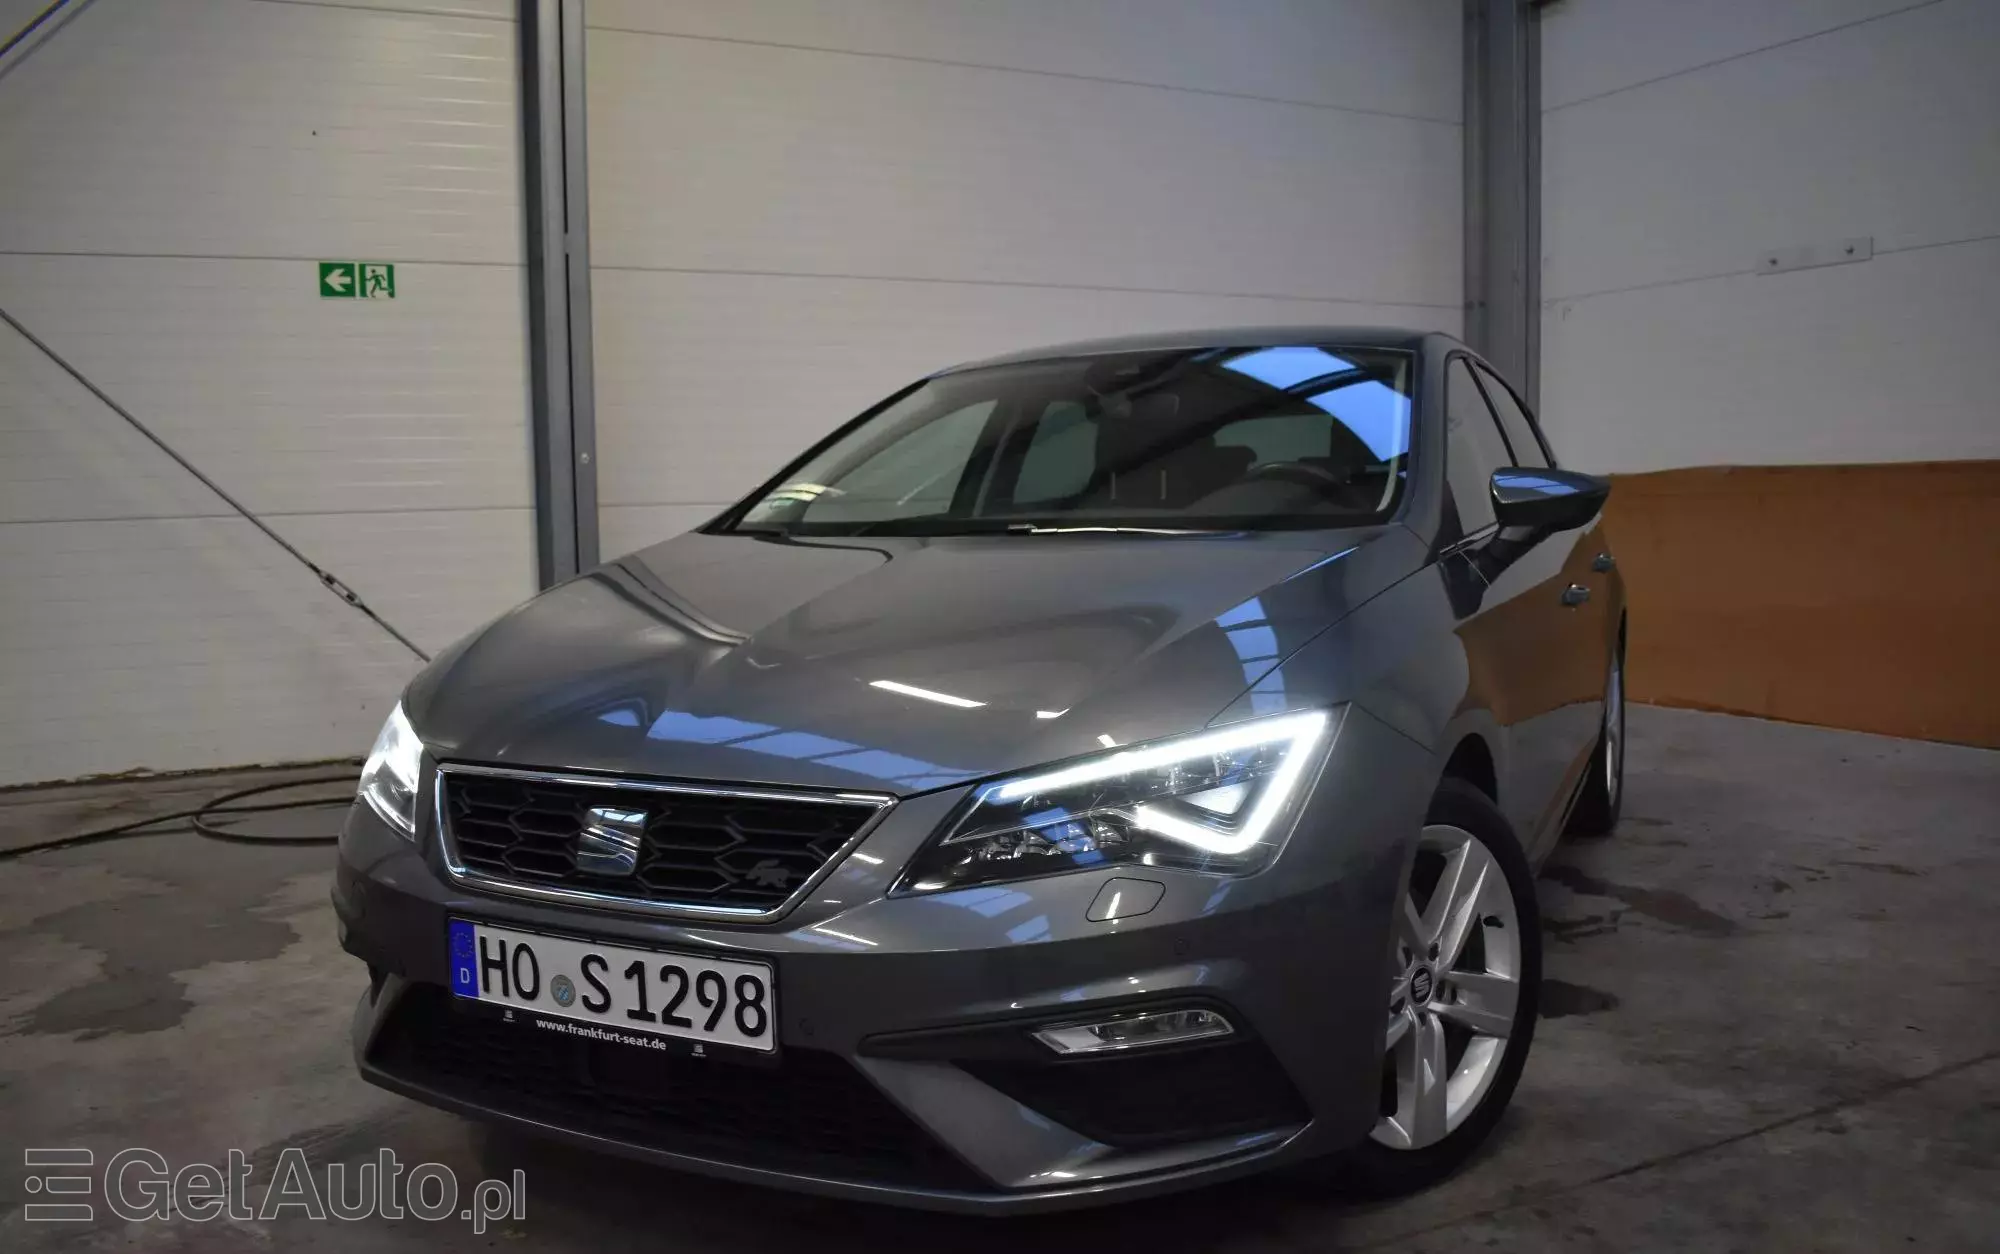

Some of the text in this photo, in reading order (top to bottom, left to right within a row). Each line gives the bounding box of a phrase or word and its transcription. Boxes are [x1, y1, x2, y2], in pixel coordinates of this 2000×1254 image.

[459, 966, 471, 985] D
[479, 935, 541, 1002] HO
[536, 1018, 667, 1051] www.frankfurt-seat.de
